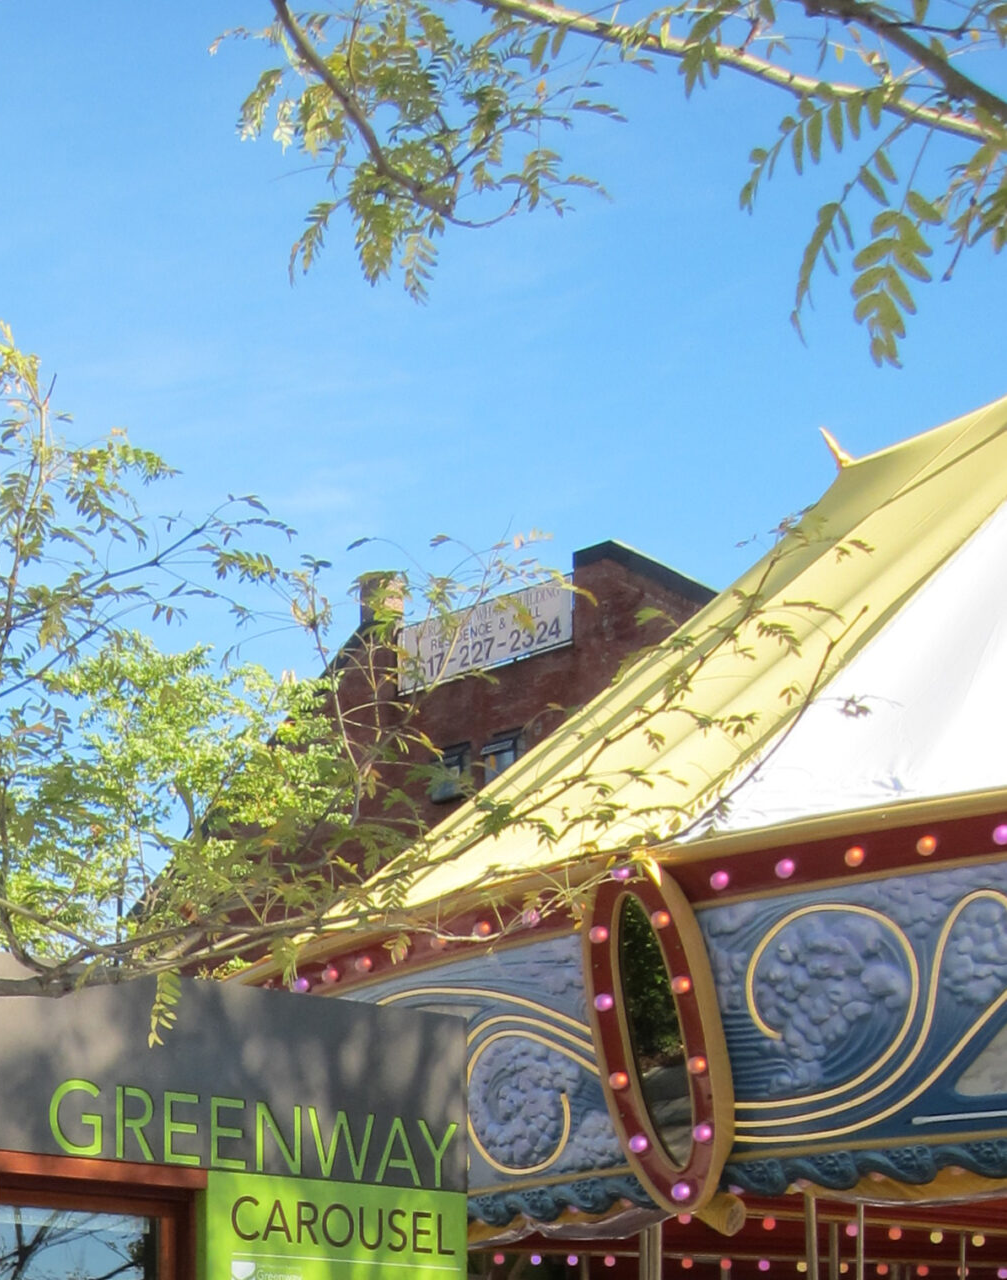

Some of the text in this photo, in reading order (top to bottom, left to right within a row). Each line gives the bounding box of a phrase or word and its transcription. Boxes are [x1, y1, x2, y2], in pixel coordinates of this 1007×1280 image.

[430, 622, 492, 650] REENCE
[49, 1079, 459, 1188] GREENWAY
[231, 1195, 455, 1256] CAROUSEL
